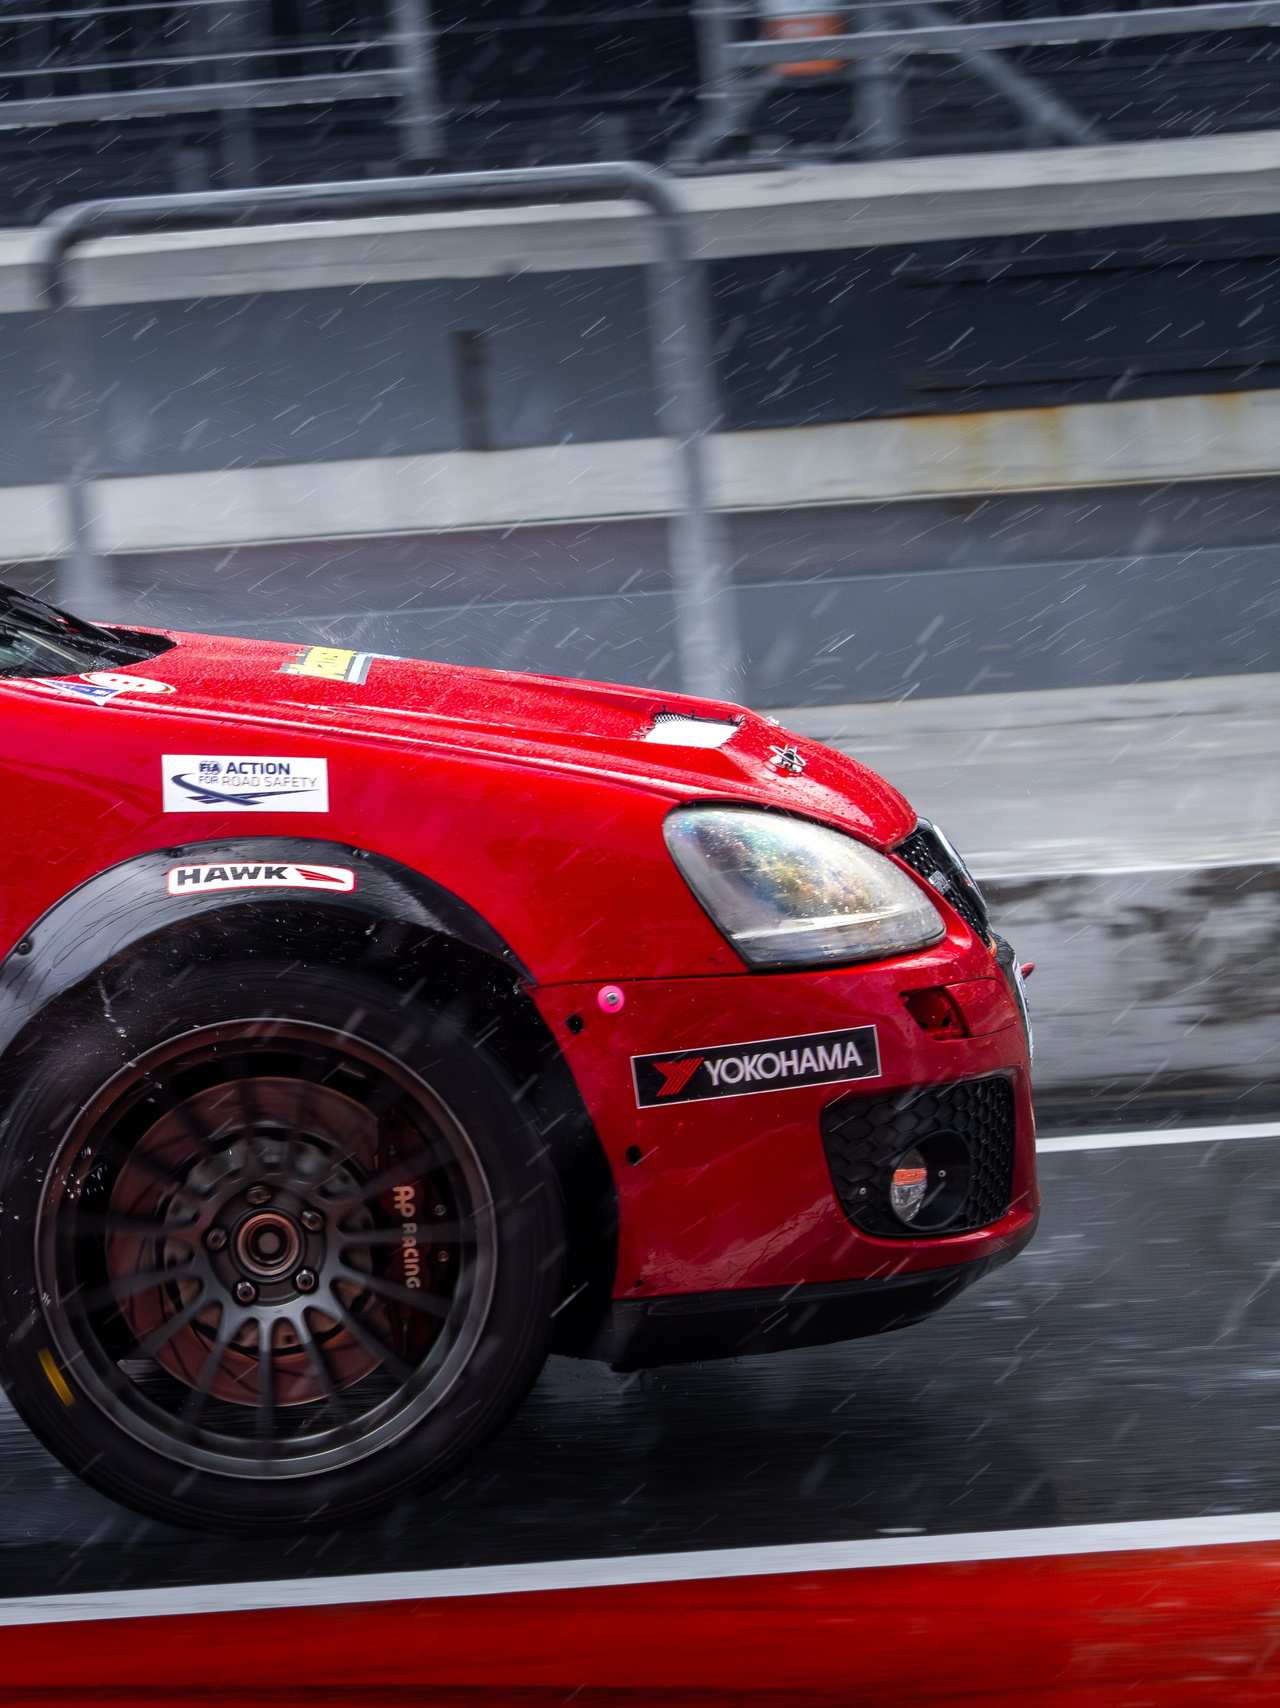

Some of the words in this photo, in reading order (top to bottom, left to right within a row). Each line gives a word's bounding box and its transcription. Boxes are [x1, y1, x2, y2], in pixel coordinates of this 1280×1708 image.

[199, 762, 220, 774] FIA
[226, 762, 290, 775] ACTION
[199, 776, 219, 784] FOR
[222, 776, 261, 788] ROAD
[265, 776, 318, 788] SAFETY
[177, 866, 289, 886] HAWK
[704, 1041, 863, 1086] YOKOHAMA
[402, 1222, 421, 1289] RACING
